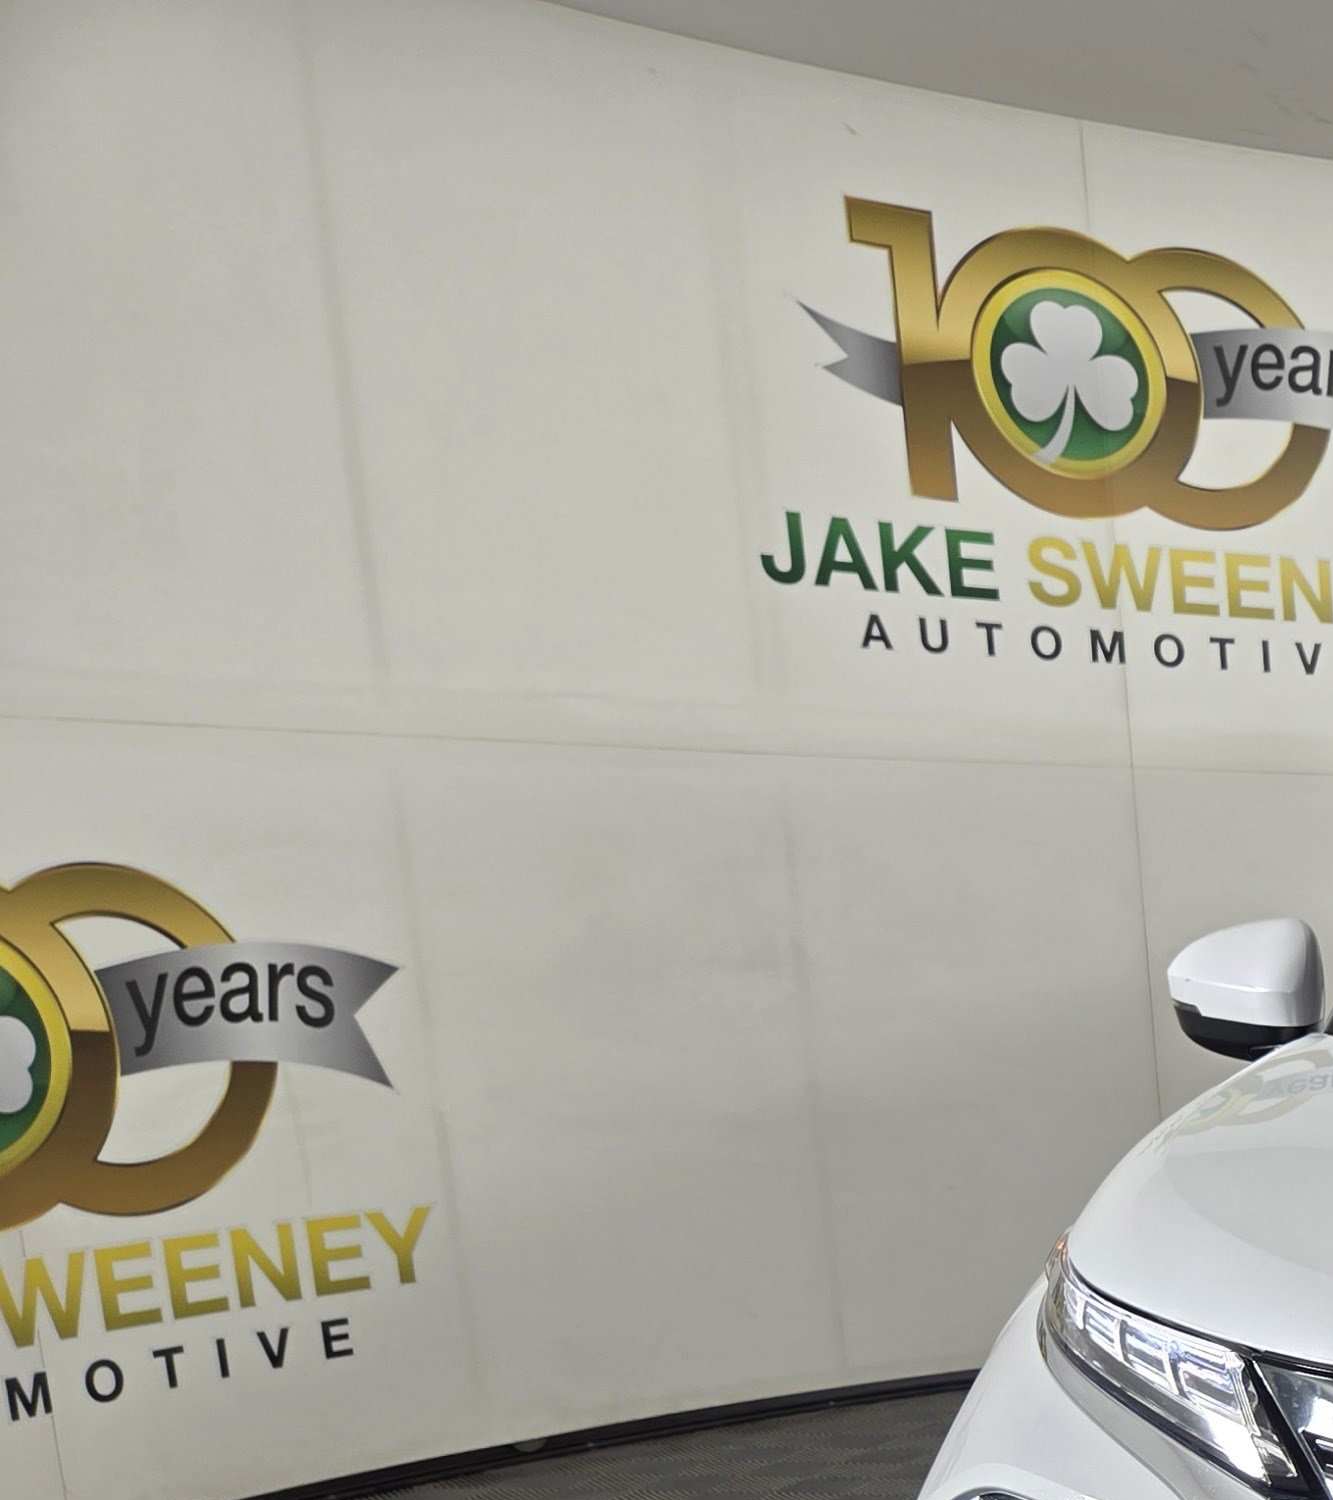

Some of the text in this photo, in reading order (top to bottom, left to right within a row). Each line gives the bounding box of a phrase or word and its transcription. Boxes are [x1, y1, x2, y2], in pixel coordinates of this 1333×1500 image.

[843, 194, 1331, 531] 100
[760, 510, 1001, 601] JAKE
[125, 961, 336, 1057] years
[5, 1318, 354, 1421] MOTIVE
